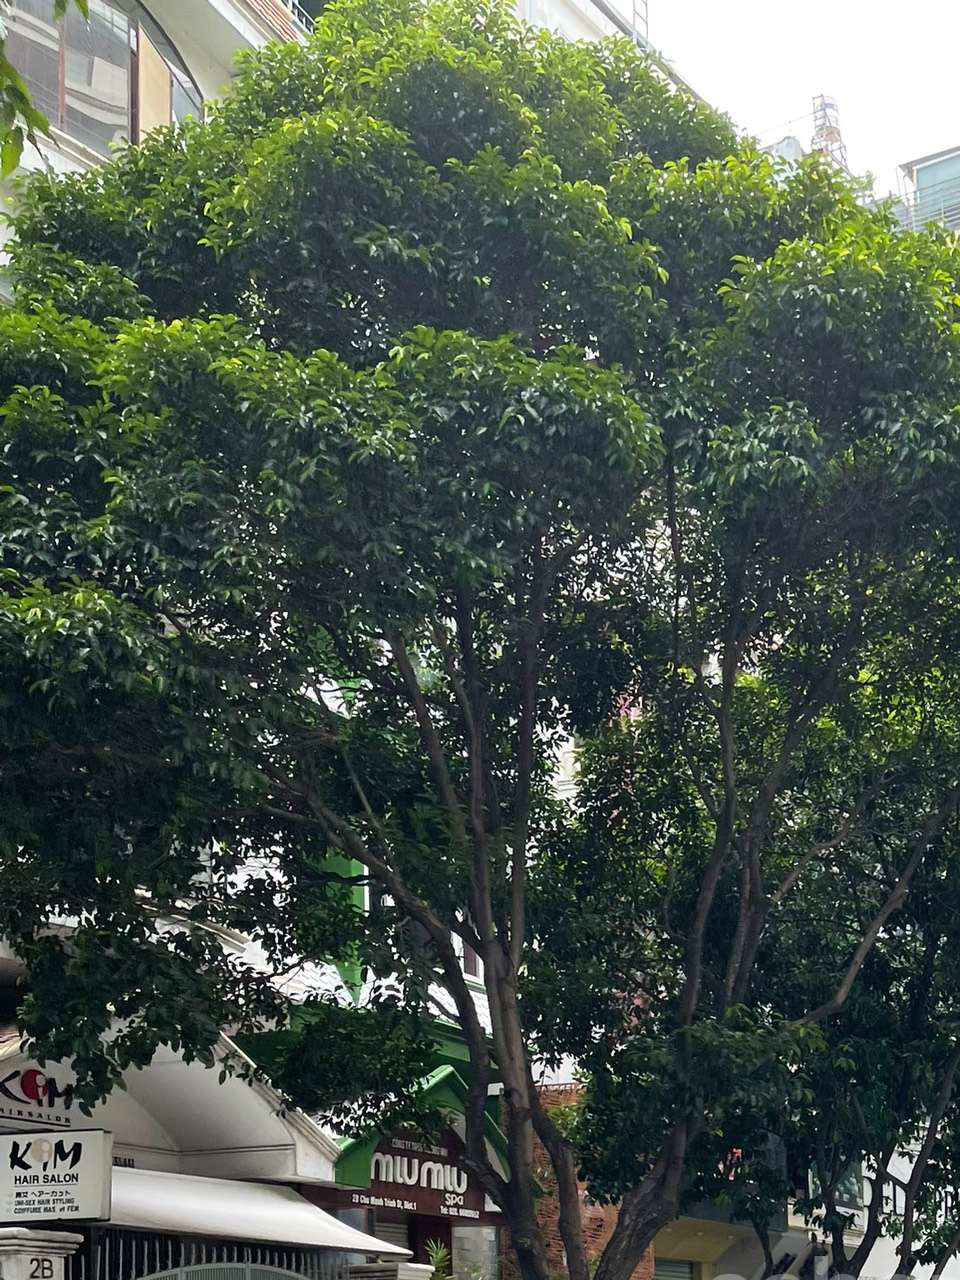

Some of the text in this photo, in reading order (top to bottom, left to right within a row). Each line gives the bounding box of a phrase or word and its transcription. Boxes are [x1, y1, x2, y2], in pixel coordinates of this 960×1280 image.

[14, 1173, 79, 1185] HAIR SALON
[30, 1258, 54, 1279] 2B
